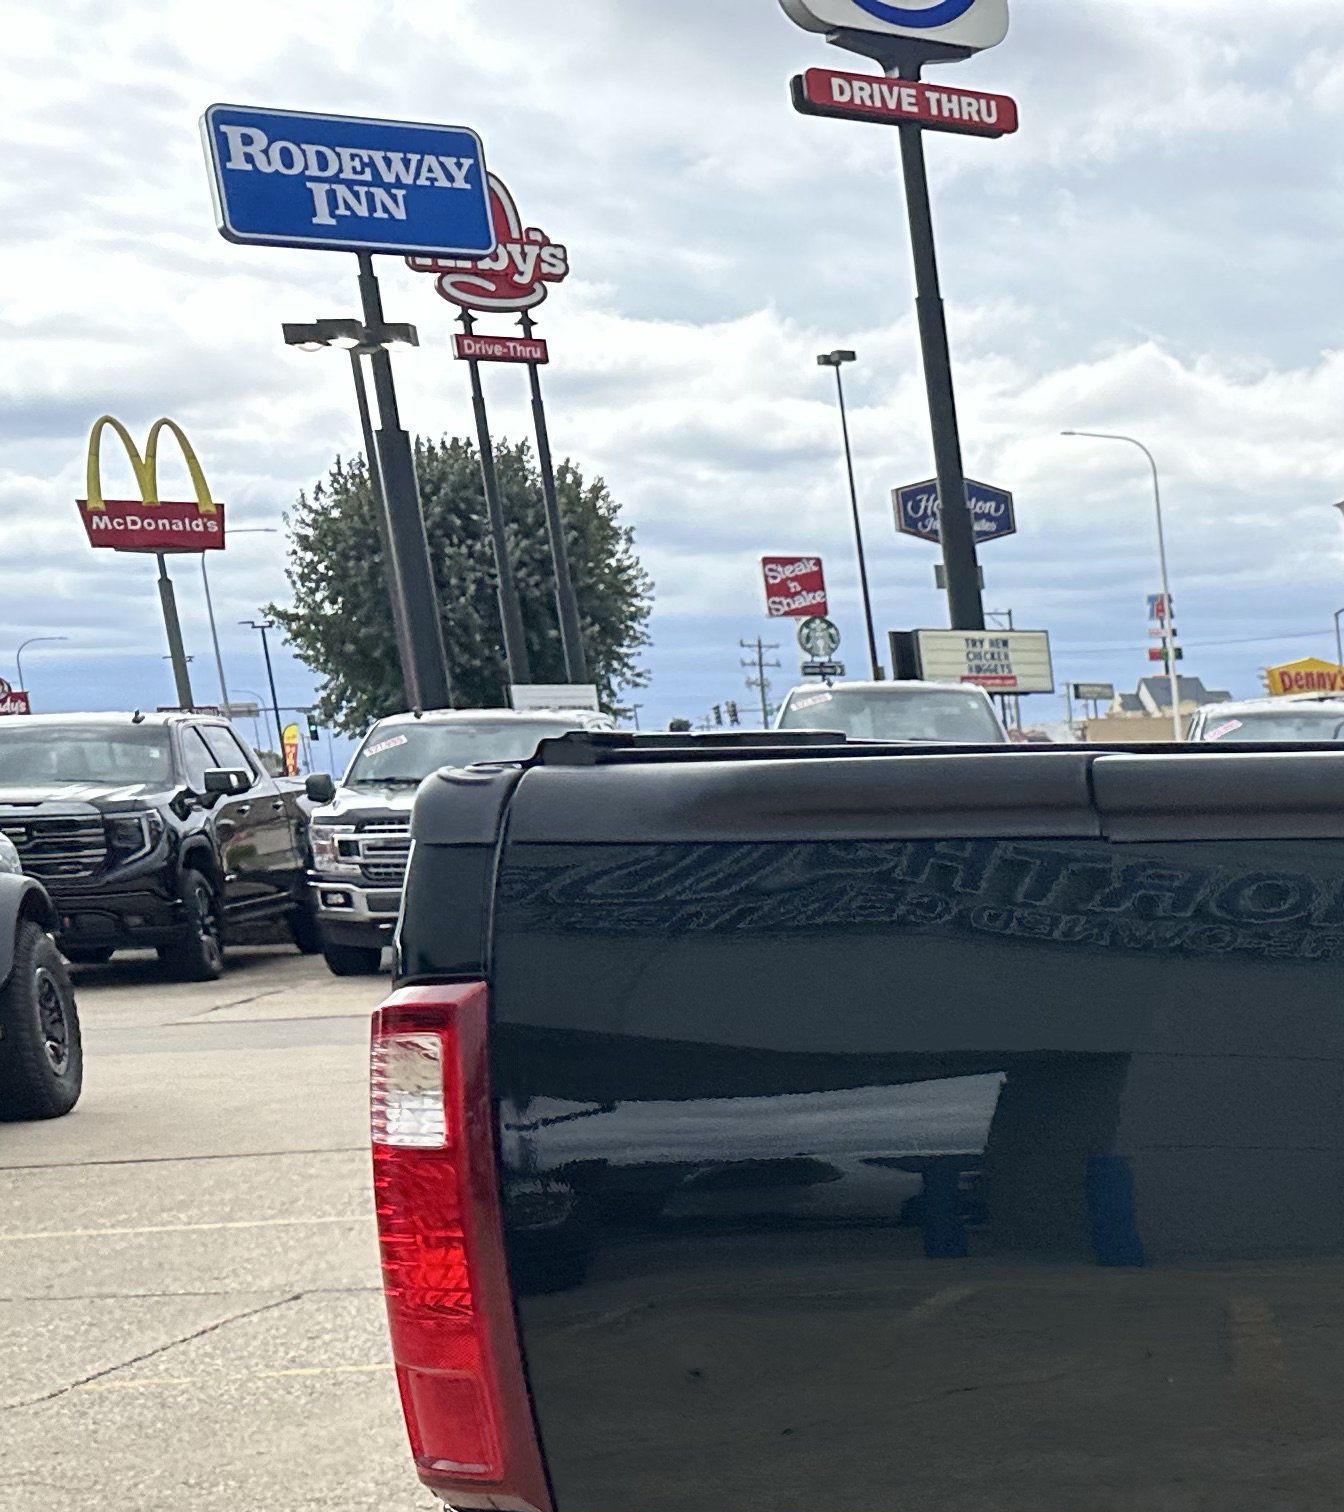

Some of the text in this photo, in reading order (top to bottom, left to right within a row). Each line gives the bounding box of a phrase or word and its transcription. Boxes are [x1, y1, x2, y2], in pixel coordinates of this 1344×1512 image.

[829, 76, 998, 124] DRIVE THRU
[219, 124, 475, 190] RODEWAY
[306, 181, 407, 226] INN
[410, 230, 567, 284] by's
[463, 339, 541, 358] Drive-Thru
[91, 514, 219, 533] McDonald's
[765, 558, 819, 584] Steak
[768, 589, 827, 616] Shake
